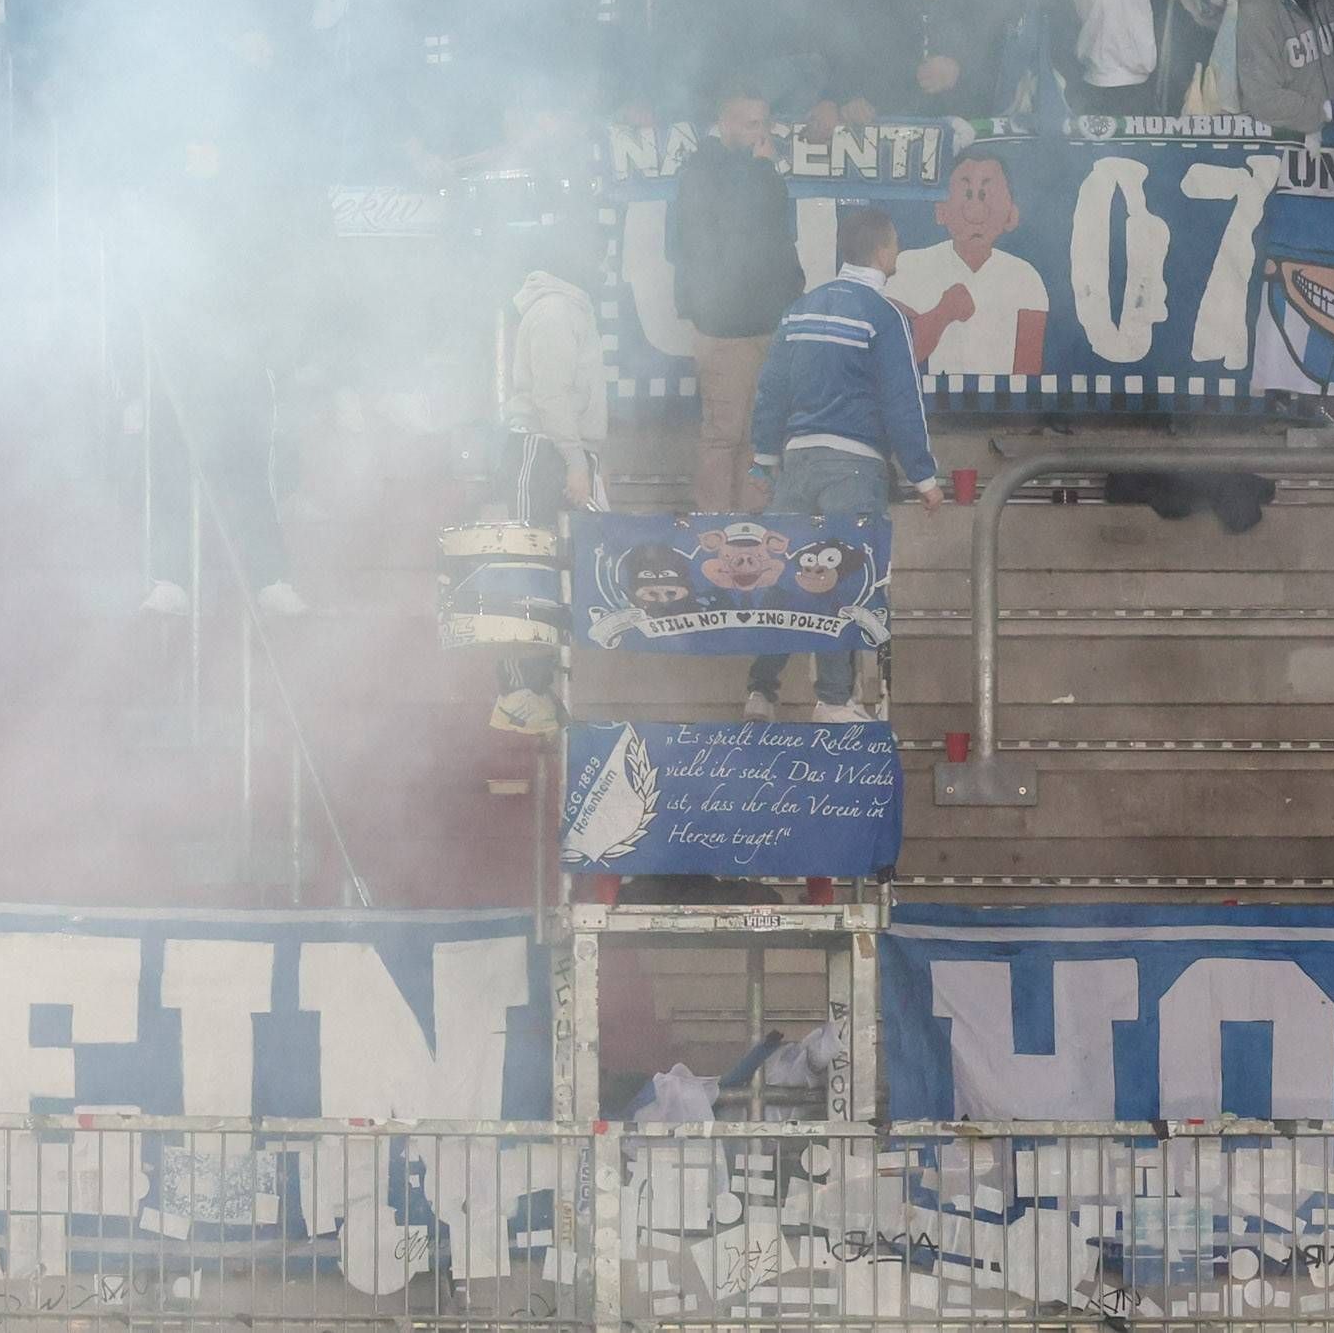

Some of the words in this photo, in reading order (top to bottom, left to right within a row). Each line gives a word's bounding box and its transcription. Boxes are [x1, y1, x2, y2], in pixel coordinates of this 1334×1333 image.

[649, 618, 695, 634] STILL
[698, 611, 728, 629] NOT
[789, 612, 842, 634] POLICE
[705, 721, 754, 750] spielt
[758, 722, 804, 748] keine
[810, 723, 864, 756] Rolle
[578, 756, 601, 789] 1899
[665, 749, 706, 778] viele
[709, 746, 742, 778] ihr
[787, 760, 827, 784] Das
[573, 769, 618, 835] Hoffenheim
[666, 793, 693, 815] ist,
[700, 782, 735, 813] dass
[741, 781, 775, 813] ihr
[770, 784, 801, 815] den
[807, 794, 862, 818] Verein
[667, 820, 728, 850] Herzen
